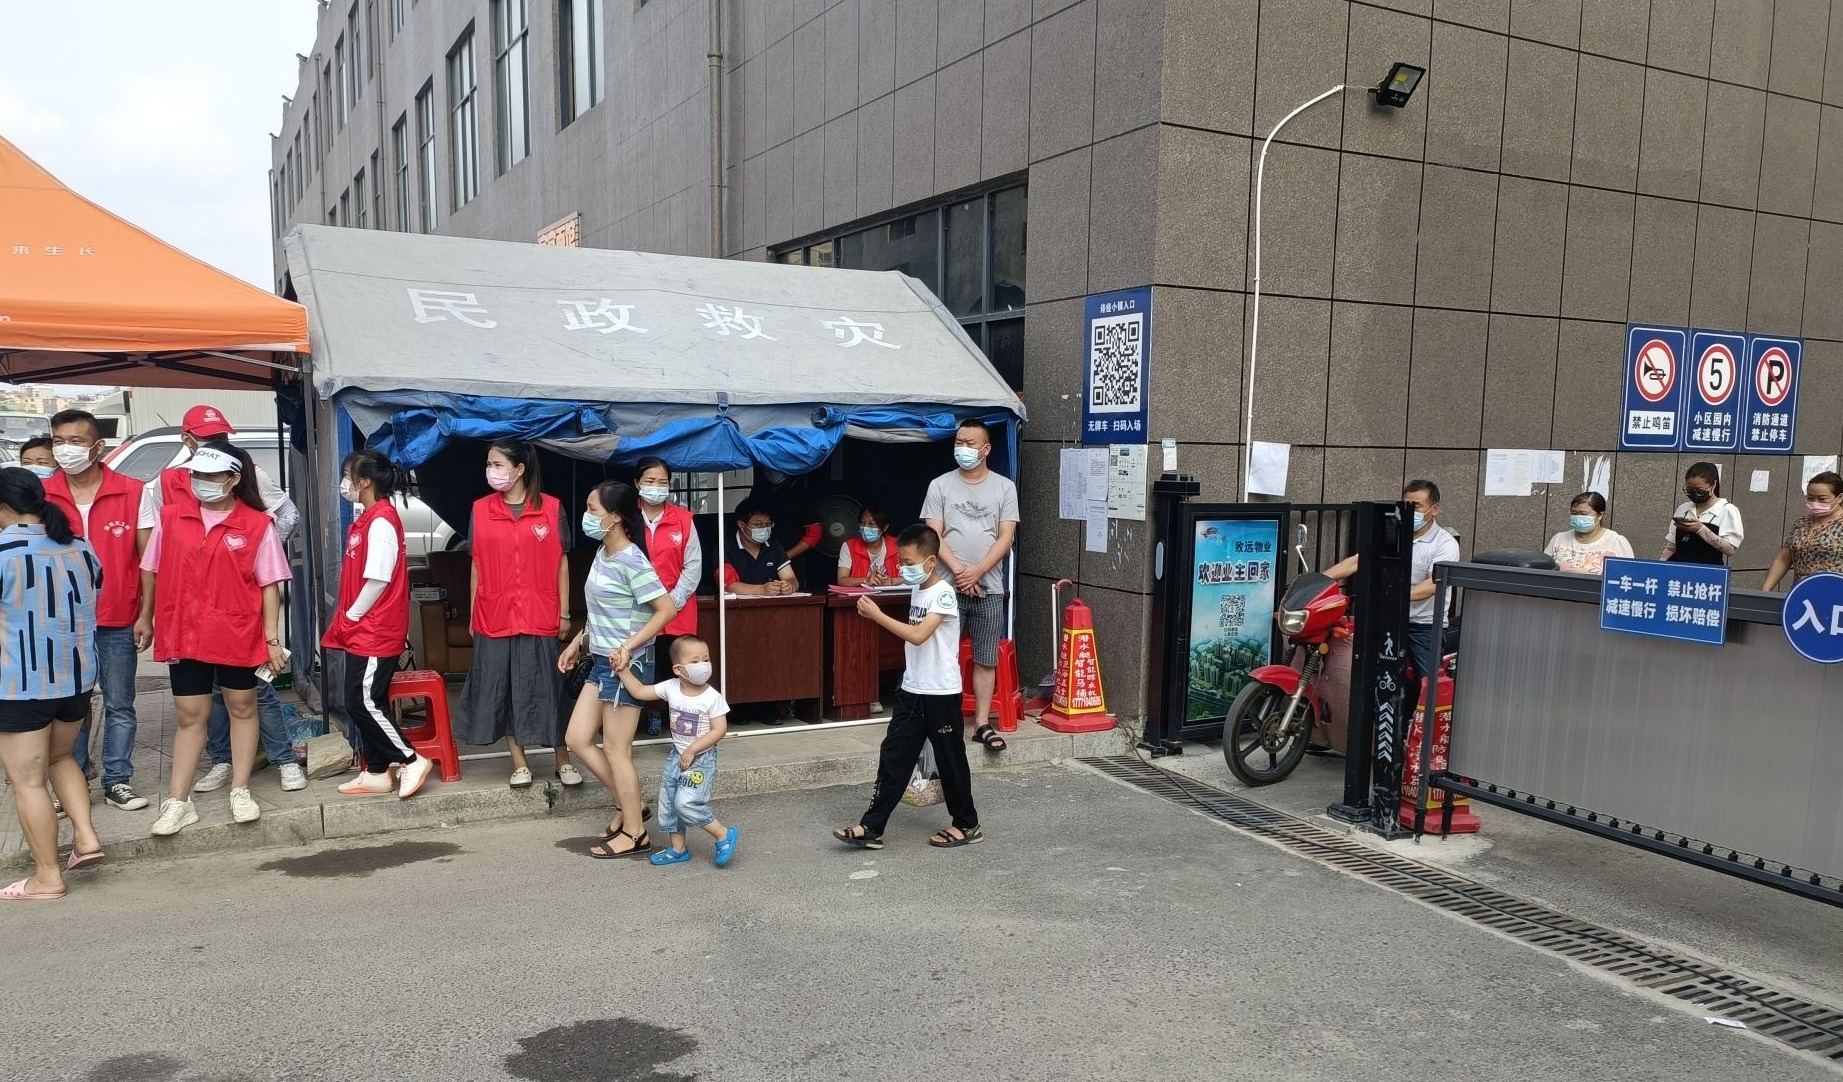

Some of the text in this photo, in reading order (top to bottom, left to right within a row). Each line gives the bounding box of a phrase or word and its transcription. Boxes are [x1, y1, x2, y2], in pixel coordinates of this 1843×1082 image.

[407, 288, 902, 350] 民政救灾
[1709, 358, 1723, 391] 5
[1088, 419, 1142, 431] 无牌车 扫码入场
[1631, 415, 1672, 430] 禁止鸣笛
[1693, 411, 1732, 426] 小区园内
[1752, 412, 1789, 427] 消防通道
[1692, 427, 1731, 442] 减速慢行
[1751, 428, 1788, 442] 禁止停车
[1234, 540, 1272, 553] 致远物业
[1198, 560, 1271, 584] 欢迎业主回家
[1607, 575, 1722, 602] 一车一杆 禁止抢杆
[1605, 597, 1721, 628] 减速慢行 损坏赔偿
